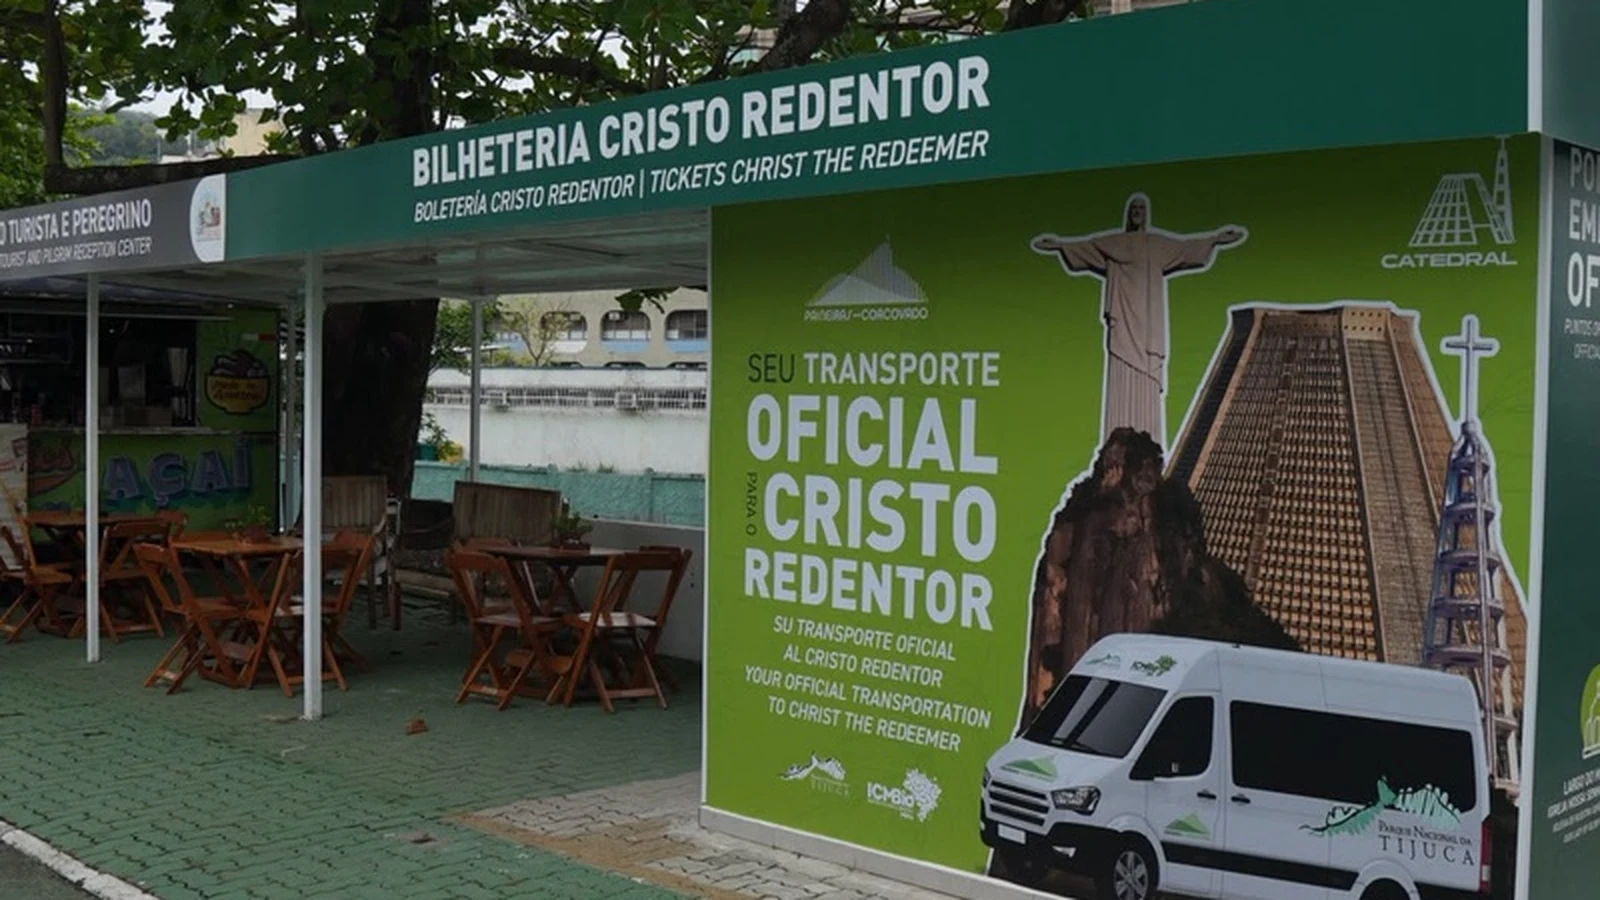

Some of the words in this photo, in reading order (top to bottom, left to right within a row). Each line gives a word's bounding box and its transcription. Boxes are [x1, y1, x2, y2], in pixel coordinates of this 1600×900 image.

[413, 121, 590, 187] BILHETERIA
[599, 96, 730, 159] CRISTO
[742, 55, 991, 139] REDENTOR
[414, 189, 488, 223] BOLETERÍA
[490, 186, 544, 213] CRISTO
[548, 173, 635, 206] REDENTOR
[650, 161, 726, 193] TICKETS
[731, 151, 808, 184] CHRIST
[814, 146, 856, 176] THE
[860, 129, 990, 170] REDEEMER
[1570, 147, 1600, 193] PO
[8, 213, 59, 244] TURISTA
[61, 211, 70, 237] E
[72, 198, 152, 236] PEREGRINO
[1569, 198, 1600, 244] EM
[117, 236, 152, 257] CENTER
[1381, 251, 1518, 269] CATEDRAL
[748, 353, 795, 383] SEU
[803, 352, 1000, 386] TRANSPORTE
[747, 393, 999, 475] OFICIAL
[746, 472, 758, 518] PARA
[763, 472, 997, 563] CRISTO
[745, 523, 758, 537] O
[744, 547, 993, 631] REDENTOR
[773, 615, 793, 634] SU
[797, 619, 893, 650] TRANSPORTE
[896, 635, 956, 661] OFICIAL
[783, 644, 801, 662] AL
[805, 647, 857, 673] CRISTO
[860, 659, 943, 688] REDENTOR
[744, 665, 782, 688] YOUR
[784, 673, 847, 701] OFFICIAL
[851, 685, 992, 729] TRANSPORTATION
[768, 696, 785, 715] TO
[789, 701, 841, 727] CHRIST
[844, 711, 873, 735] THE
[876, 718, 961, 752] REDEEMER
[867, 781, 914, 808] ICMBio
[1378, 834, 1474, 866] TIJUCA
